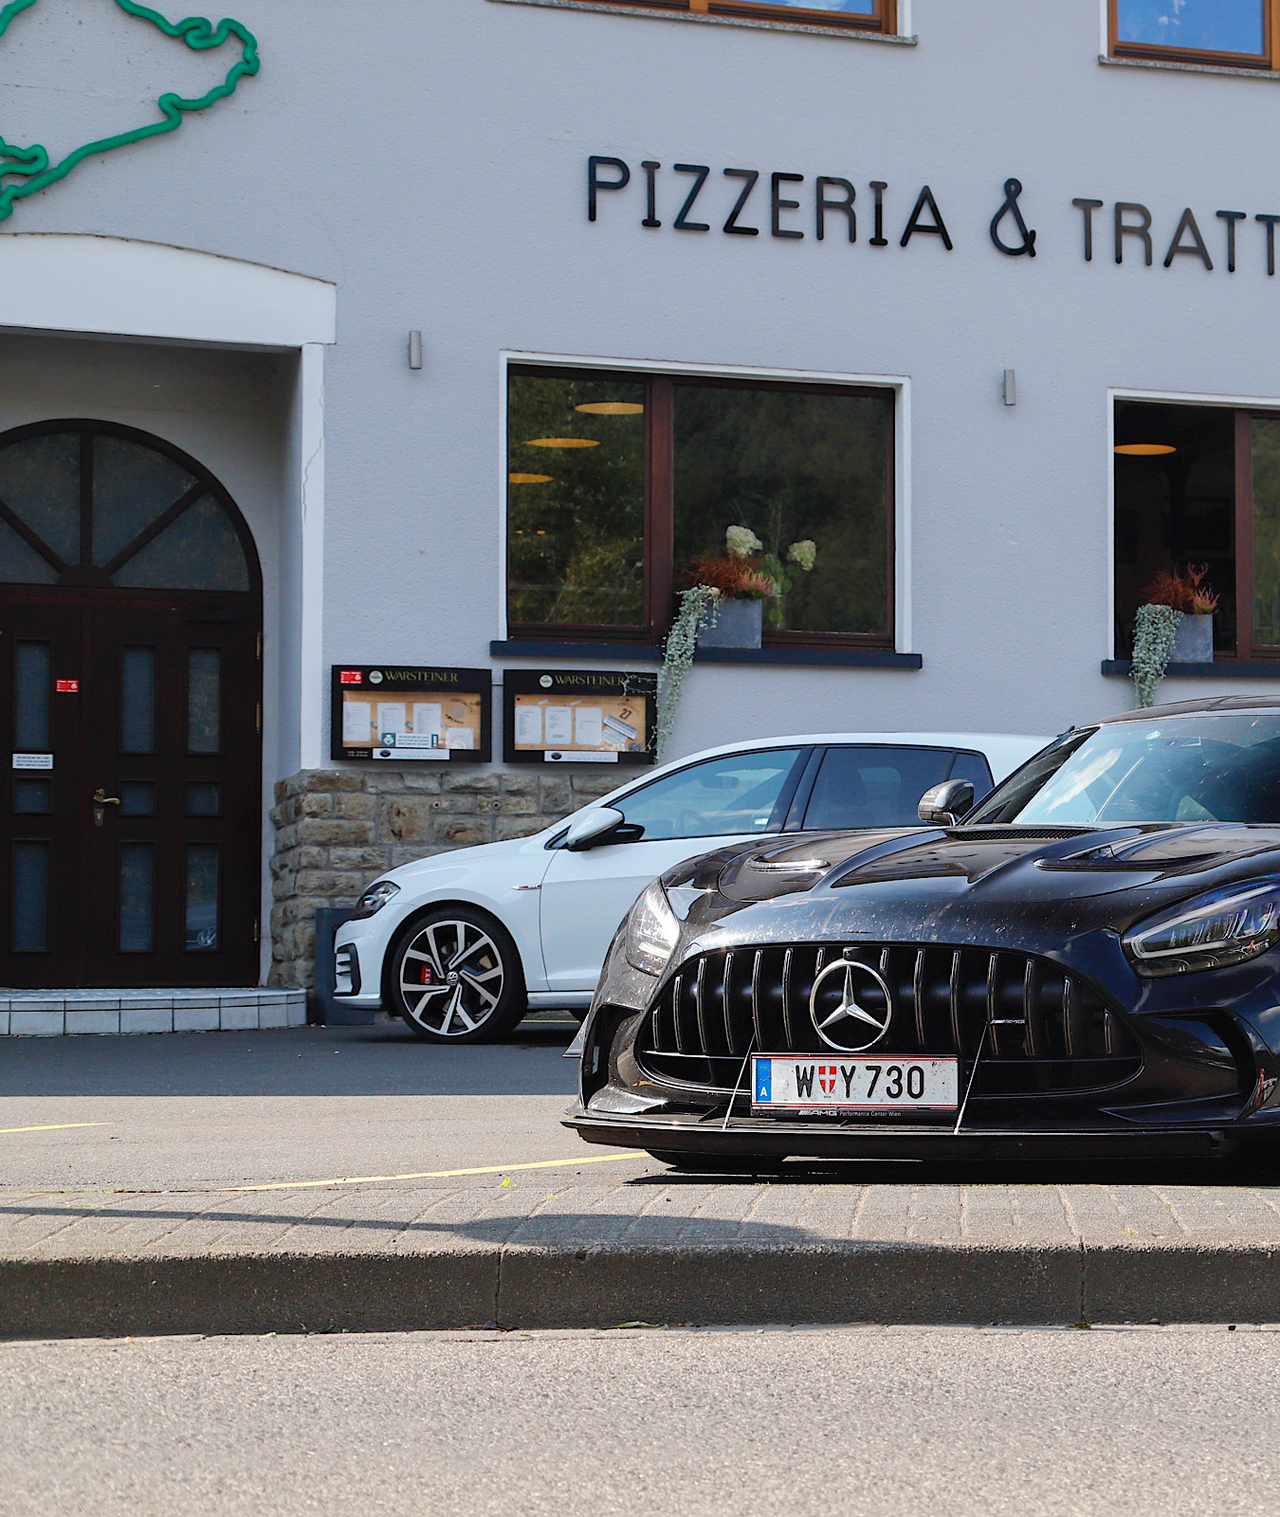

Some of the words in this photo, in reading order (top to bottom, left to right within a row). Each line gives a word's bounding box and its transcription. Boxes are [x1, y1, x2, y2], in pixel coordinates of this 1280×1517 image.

[588, 155, 953, 252] PIZZERIA
[990, 178, 1036, 258] &
[385, 670, 458, 683] WARSTEINER
[554, 674, 625, 687] WARSTEINER
[619, 708, 632, 720] 27
[759, 1086, 768, 1097] A
